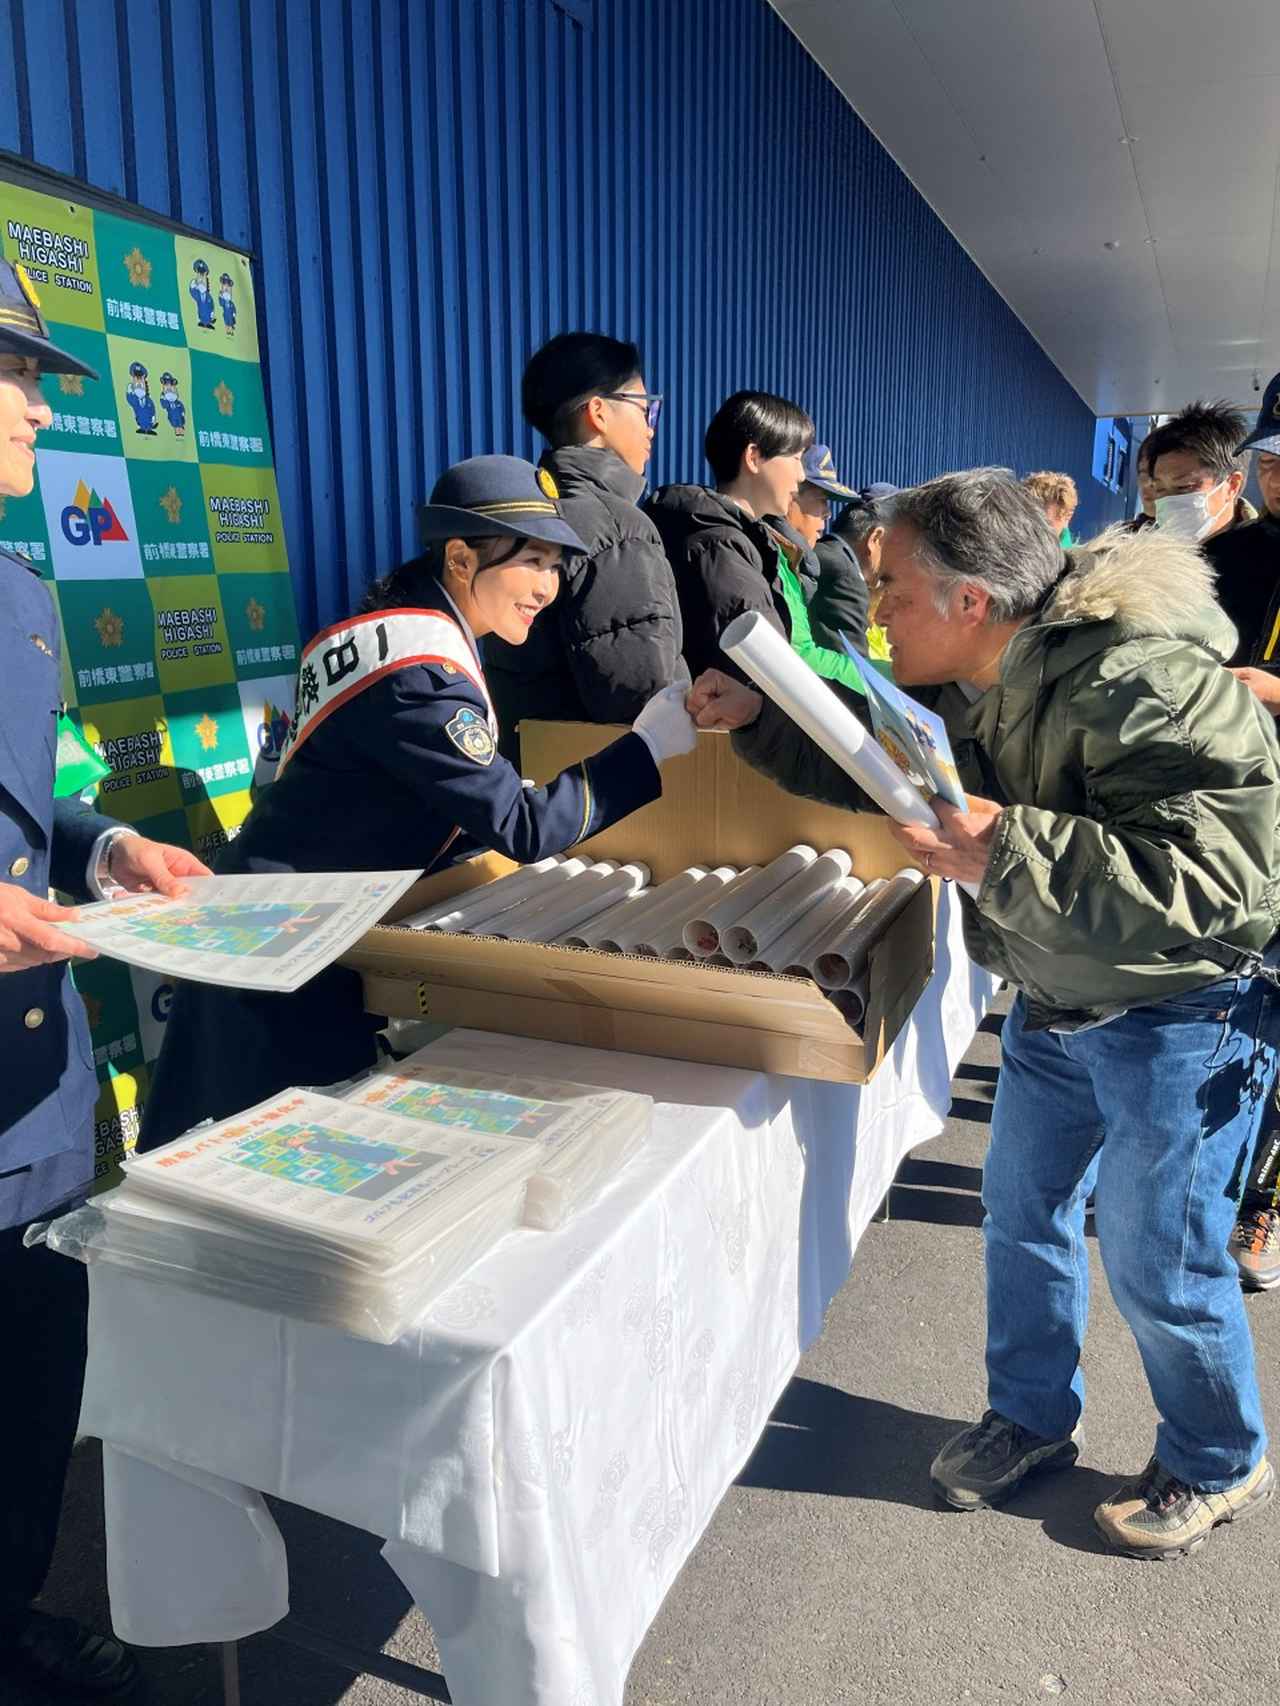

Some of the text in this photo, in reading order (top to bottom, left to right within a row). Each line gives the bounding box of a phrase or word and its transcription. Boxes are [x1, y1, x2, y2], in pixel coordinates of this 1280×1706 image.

[8, 220, 89, 260] MAEBASHI
[19, 240, 83, 274] HIGASHI
[24, 266, 93, 294] LICE STATION
[106, 298, 180, 331] 前橋東警察署
[40, 411, 118, 438] 橋東警察署
[209, 496, 270, 515] MAEBASHI
[61, 505, 112, 546] GP
[218, 512, 264, 528] HIGASHI
[242, 532, 274, 544] STATION
[158, 608, 217, 628] MAEBASHI
[164, 625, 214, 642] HIGASHI
[161, 643, 222, 660] POLICE STATION
[94, 730, 165, 758] MAEBASHI
[106, 750, 160, 773] HIGASHI
[103, 768, 169, 793] POLICE STATION
